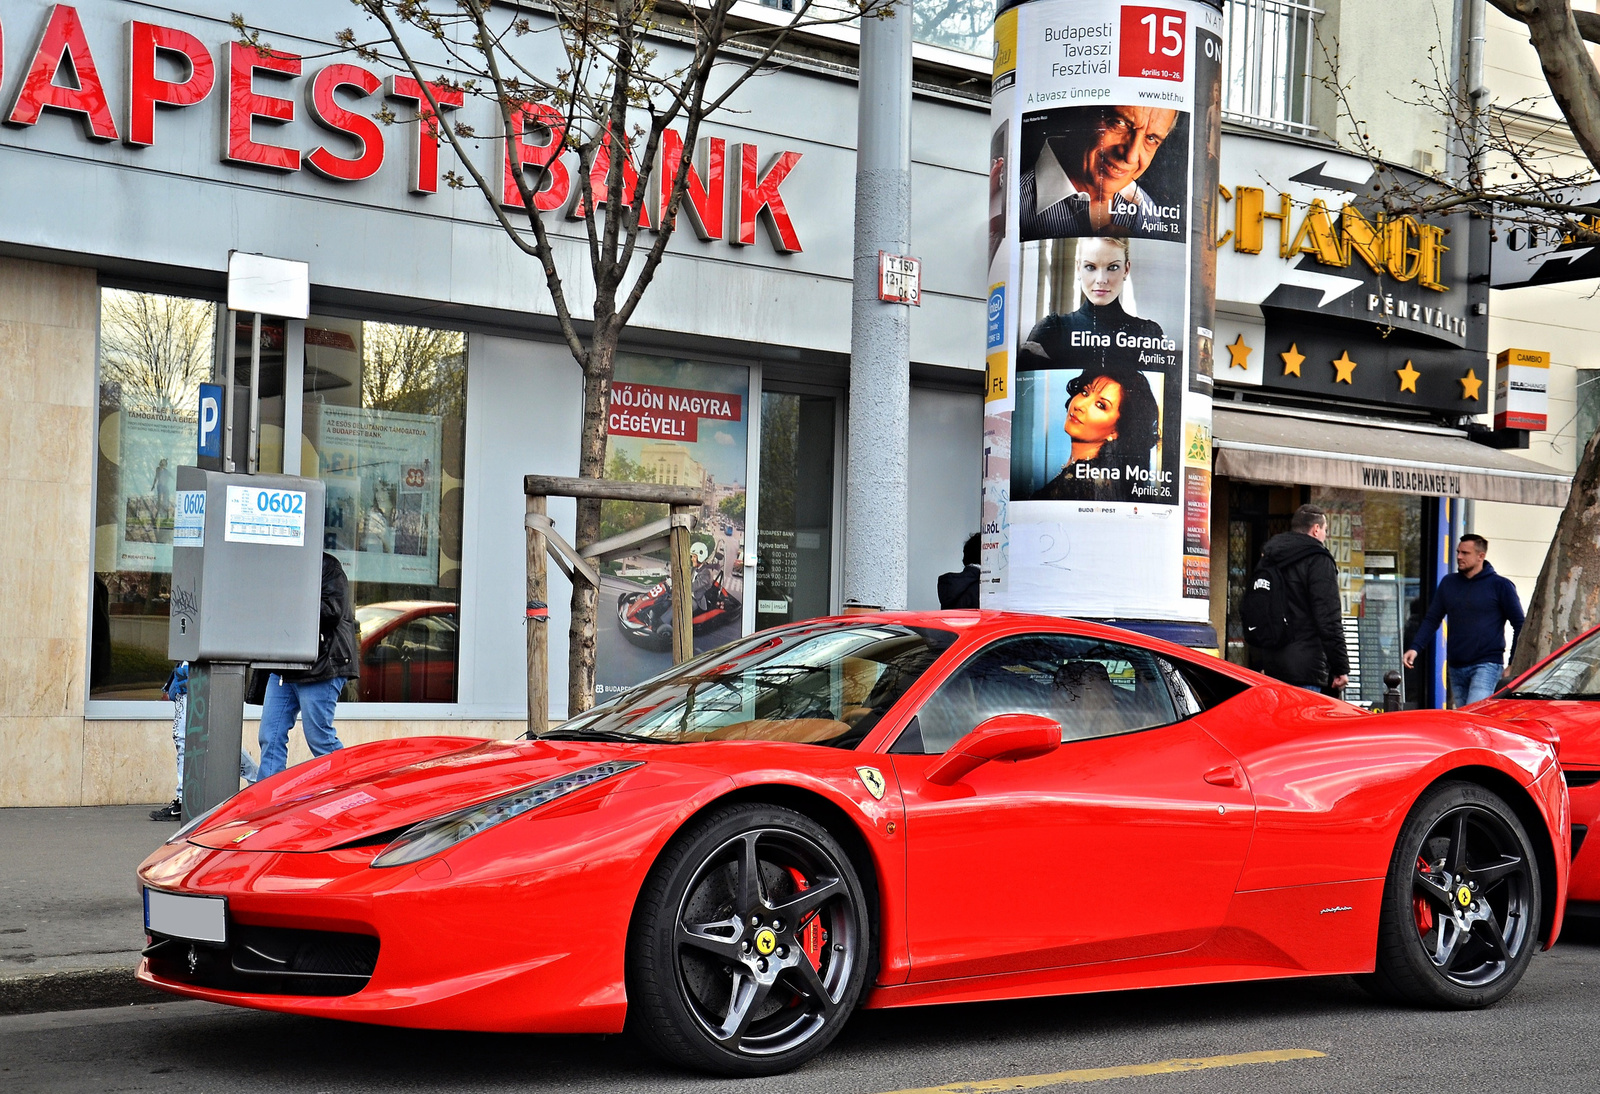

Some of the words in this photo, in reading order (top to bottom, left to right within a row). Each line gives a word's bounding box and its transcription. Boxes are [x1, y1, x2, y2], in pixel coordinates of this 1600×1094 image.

[1045, 23, 1112, 41] Budapesti
[1141, 13, 1183, 57] 15
[1063, 41, 1112, 57] Tavaszi
[1052, 59, 1111, 77] Fesztivál
[1027, 93, 1034, 104] A
[1036, 90, 1067, 102] tavasz
[1070, 87, 1111, 100] ünnepe
[1138, 90, 1184, 102] www.btf.hu
[0, 4, 464, 195] APEST
[500, 101, 803, 254] BANK
[1108, 199, 1138, 215] Leo
[1142, 200, 1180, 219] Nucci
[1142, 218, 1168, 233] Április
[1170, 223, 1180, 234] 13.
[899, 260, 914, 272] 150
[1367, 293, 1467, 337] PÉNZVÁLTÓ
[1071, 331, 1111, 347] Elīna
[1116, 332, 1175, 351] Garanča
[1138, 350, 1165, 365] Április
[1167, 355, 1176, 365] 17.
[1517, 354, 1542, 363] CAMBIO
[993, 377, 1004, 393] Ft
[611, 386, 663, 410] NŐJÖN
[669, 395, 731, 417] NAGYRA
[201, 397, 218, 446] P
[609, 410, 685, 436] CÉGÉVEL!
[332, 428, 363, 436] BUDAPEST
[1075, 463, 1120, 480] Elena
[1126, 465, 1172, 483] Mosuc
[1131, 483, 1158, 497] Április
[1160, 487, 1172, 497] 26.
[184, 493, 205, 514] 0602
[257, 491, 303, 514] 0602
